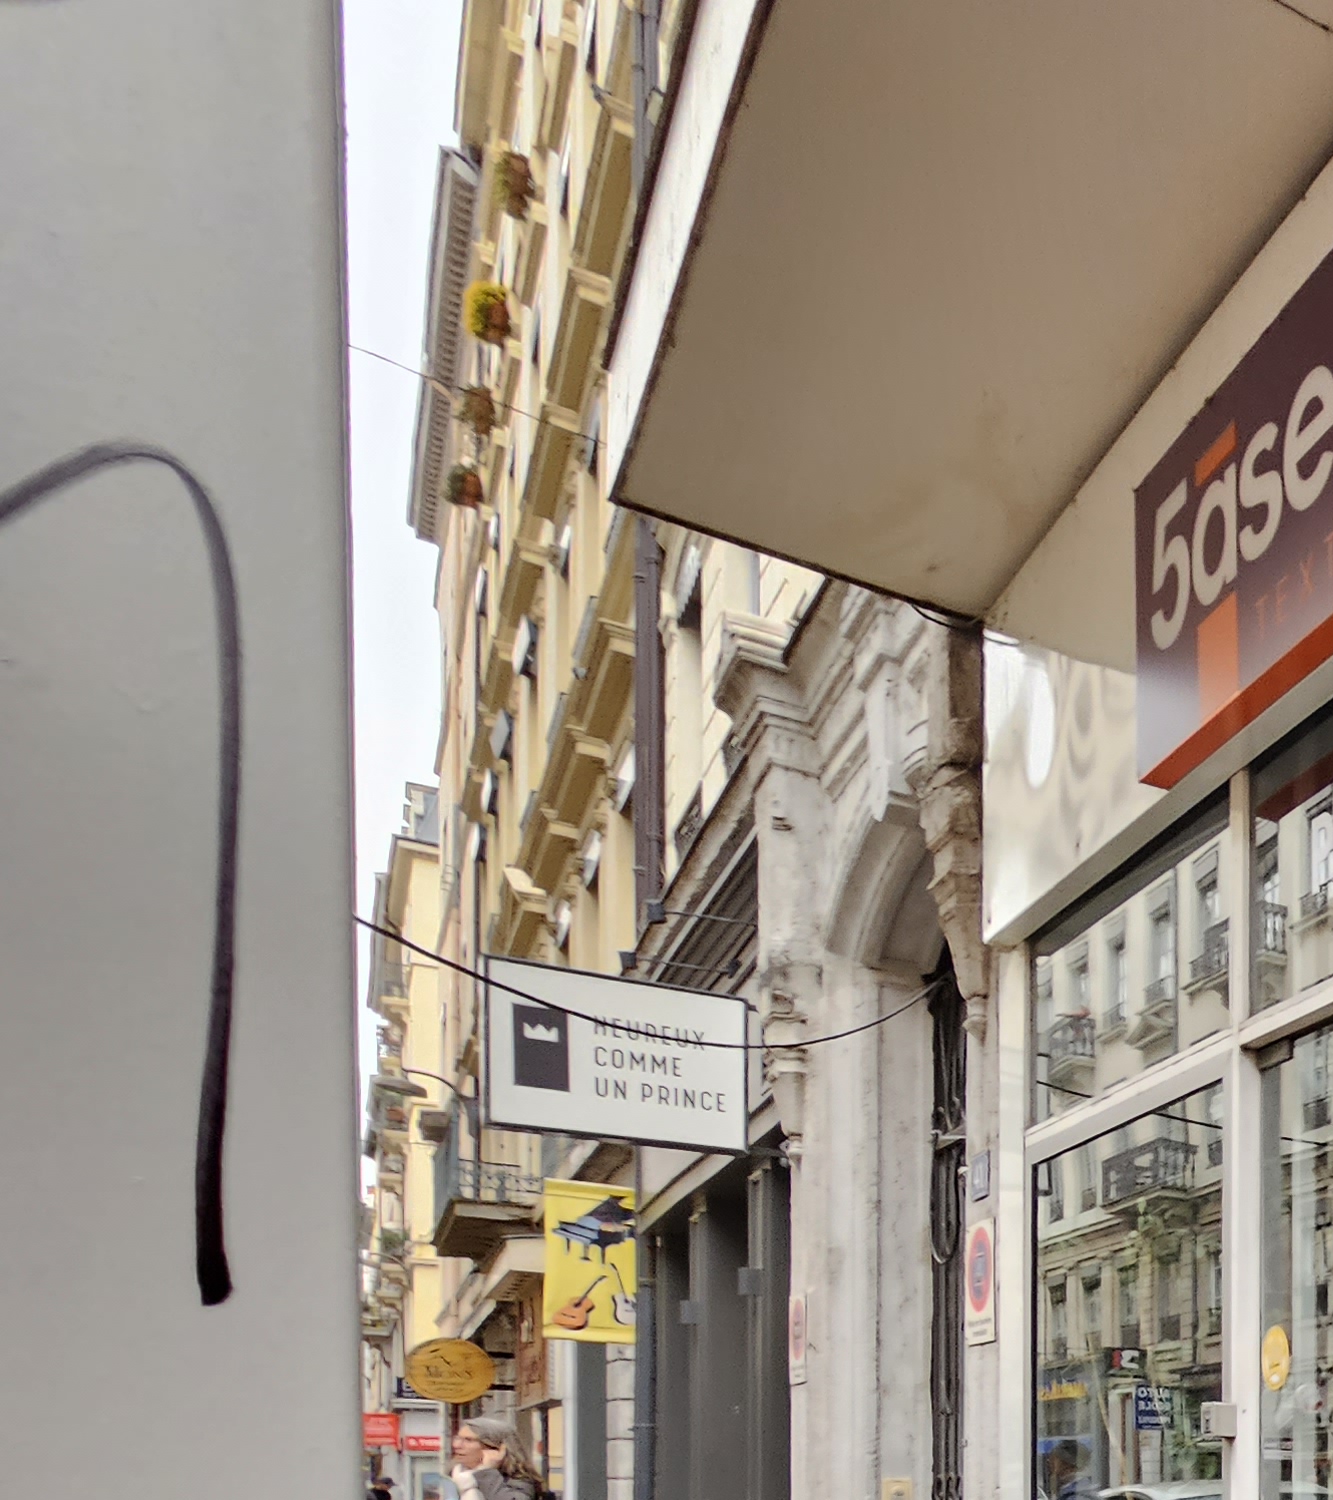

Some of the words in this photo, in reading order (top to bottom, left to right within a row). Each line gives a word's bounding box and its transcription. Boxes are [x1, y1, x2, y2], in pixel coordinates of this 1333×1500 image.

[593, 1015, 705, 1051] HEUREUX
[594, 1047, 682, 1078] COMME
[594, 1077, 628, 1101] UN
[641, 1083, 728, 1113] PRINCE
